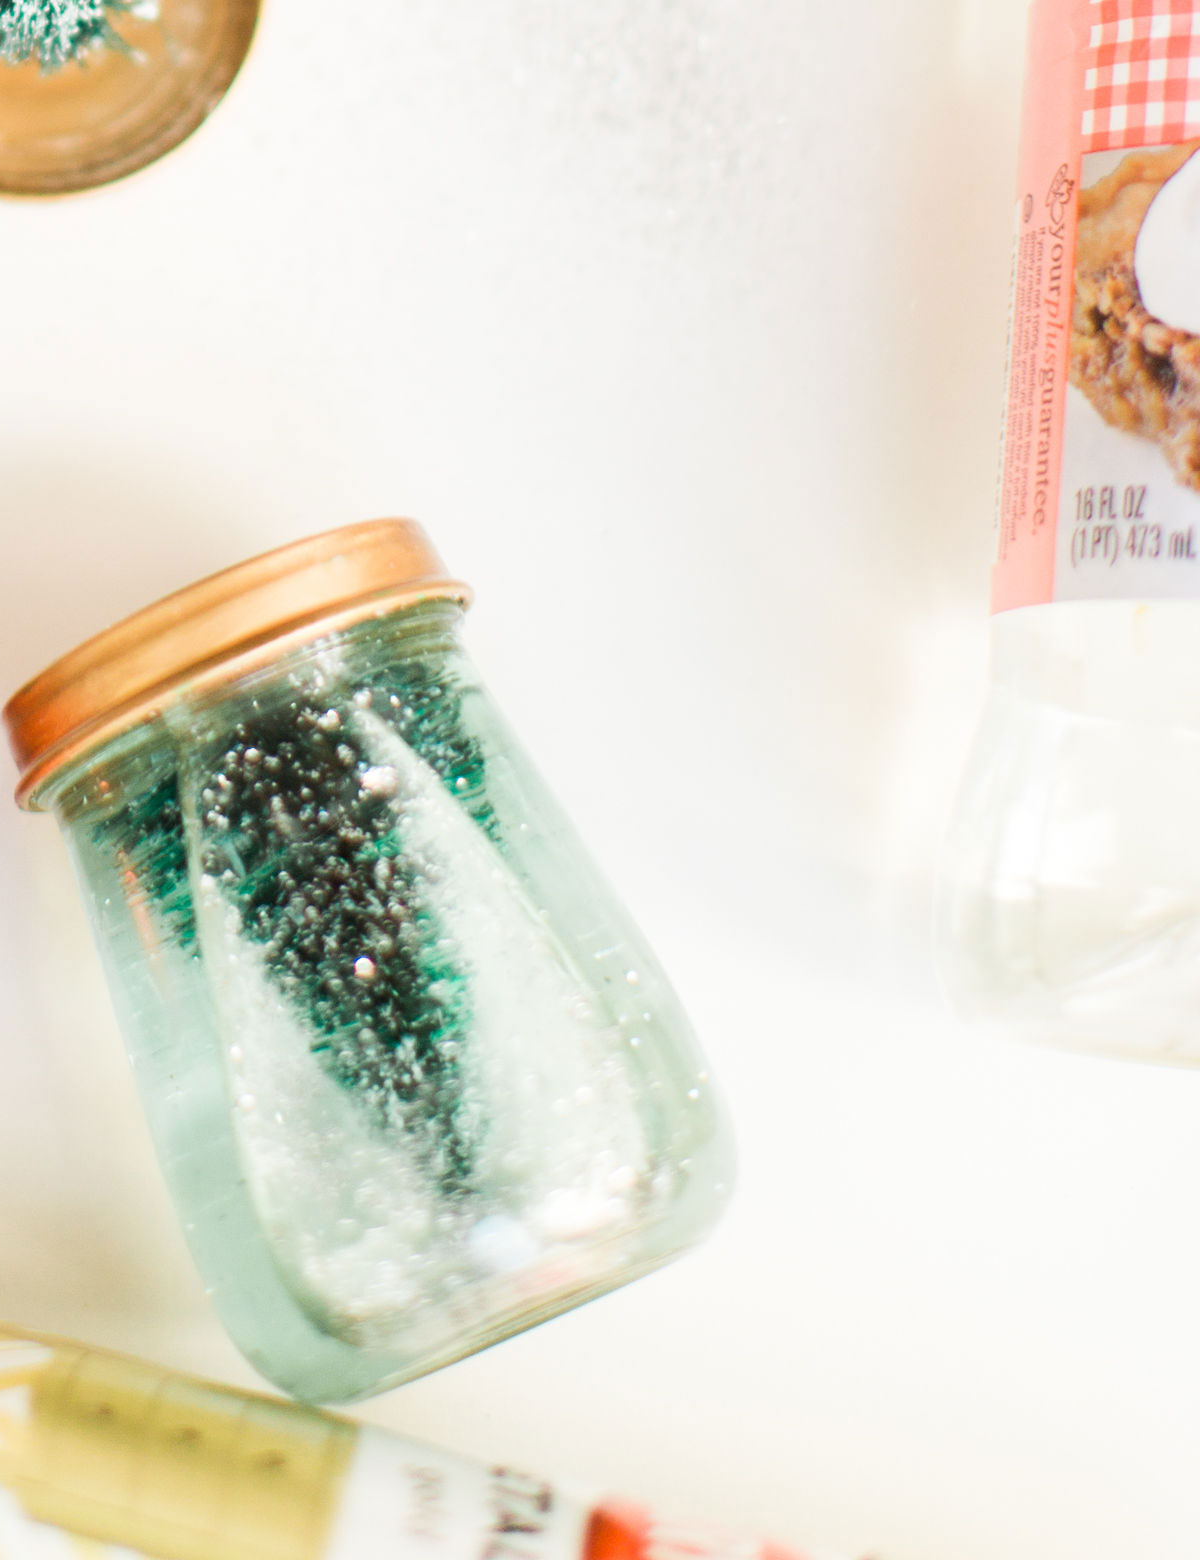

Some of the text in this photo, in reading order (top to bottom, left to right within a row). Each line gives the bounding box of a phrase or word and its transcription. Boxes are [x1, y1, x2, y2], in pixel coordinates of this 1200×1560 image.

[1075, 485, 1147, 521] 16 FL OZ
[1071, 527, 1087, 568] (1
[1091, 525, 1119, 568] PT)
[1126, 524, 1162, 559] 473
